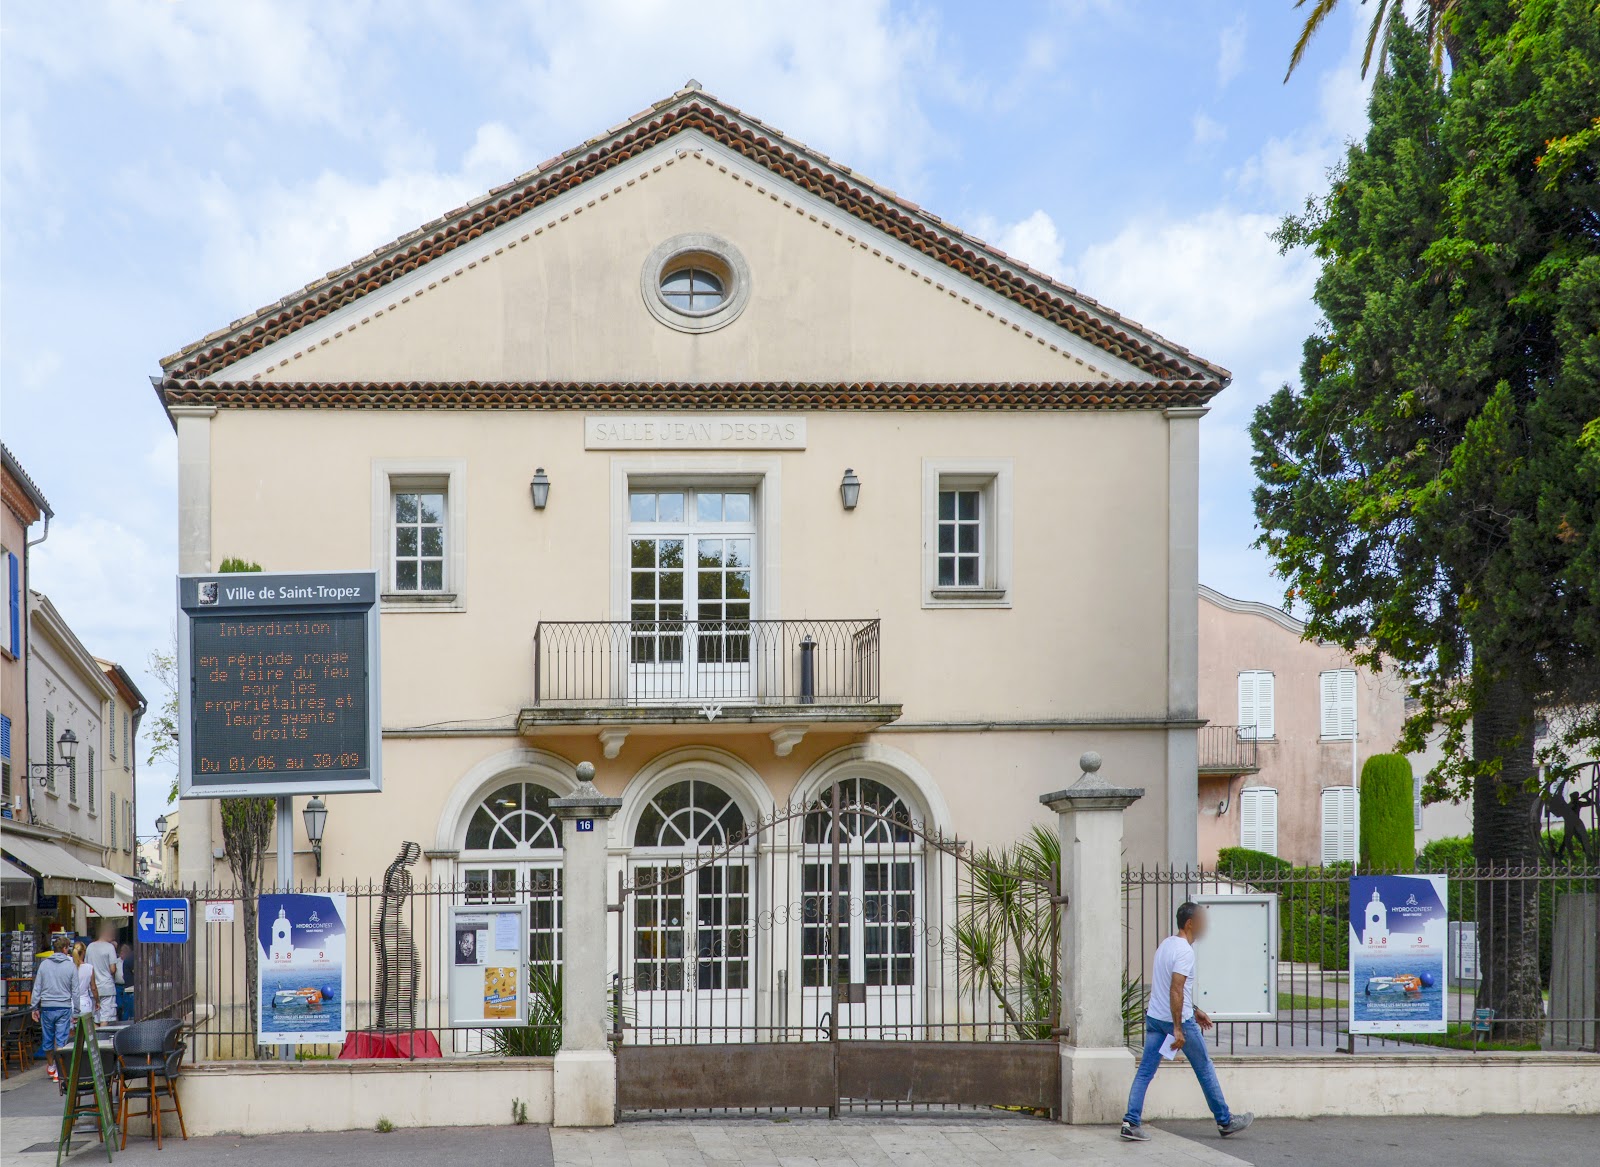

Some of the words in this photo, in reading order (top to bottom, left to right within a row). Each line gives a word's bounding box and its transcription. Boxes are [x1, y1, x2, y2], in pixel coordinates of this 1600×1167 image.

[596, 423, 654, 441] SALLE
[660, 423, 712, 441] JEAN
[720, 423, 796, 441] DESPAS
[226, 586, 255, 600] Ville
[259, 586, 275, 600] de
[279, 585, 360, 600] Saint-Tropez
[219, 622, 330, 636] Interdiction
[200, 655, 219, 666] en
[228, 652, 293, 666] période
[304, 652, 348, 665] rouge
[209, 668, 228, 682] de
[240, 666, 284, 681] faire
[294, 666, 312, 679] du
[323, 666, 349, 678] feu
[242, 683, 279, 696] pour
[291, 681, 316, 694] les
[205, 696, 326, 712] propriétaires
[336, 694, 354, 708] et
[226, 712, 271, 726] leurs
[281, 710, 335, 725] ayants
[252, 726, 308, 740] droits
[201, 757, 220, 772] Du
[229, 755, 275, 771] 01/06
[286, 757, 304, 769] au
[313, 753, 358, 768] 30/09
[580, 820, 590, 830] 16
